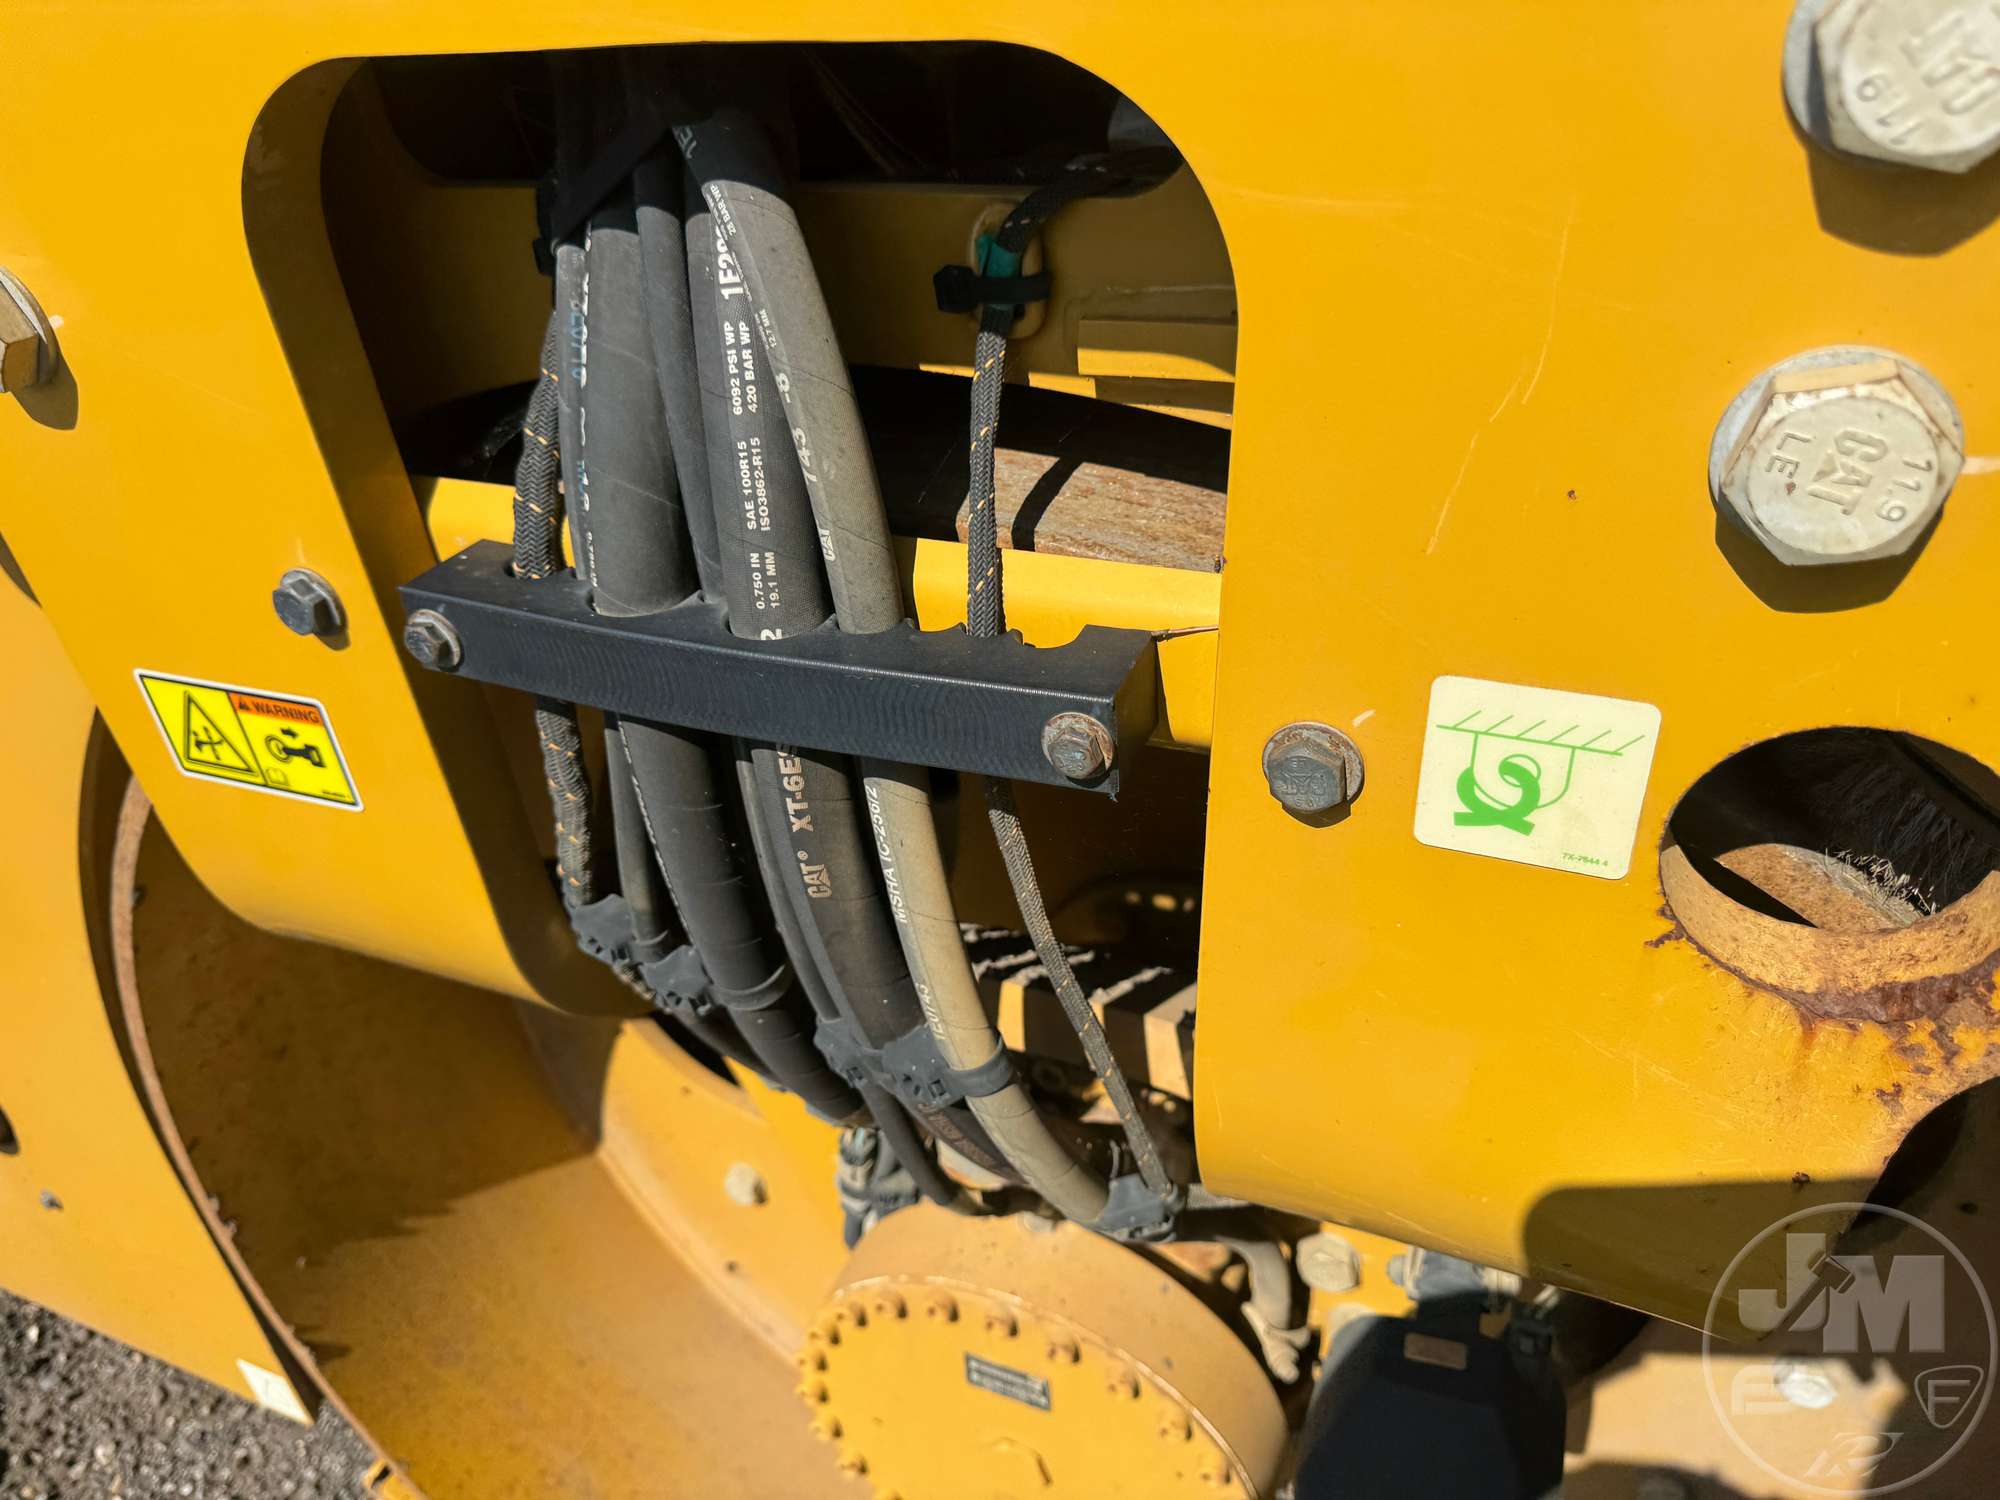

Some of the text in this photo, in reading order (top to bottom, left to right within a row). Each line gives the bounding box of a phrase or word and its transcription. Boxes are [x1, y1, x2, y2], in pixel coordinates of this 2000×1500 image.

[724, 321, 743, 415] 6092 PSI WP
[739, 321, 758, 413] 420 BAR WP
[737, 441, 757, 530] SAE 100R15
[750, 437, 771, 531] ISO3862-R15
[1808, 427, 1889, 516] CAT
[750, 551, 765, 610] 0.750 IN
[767, 551, 781, 609] 19.1 MM
[252, 701, 319, 723] WARNING
[883, 866, 907, 925] MSHA
